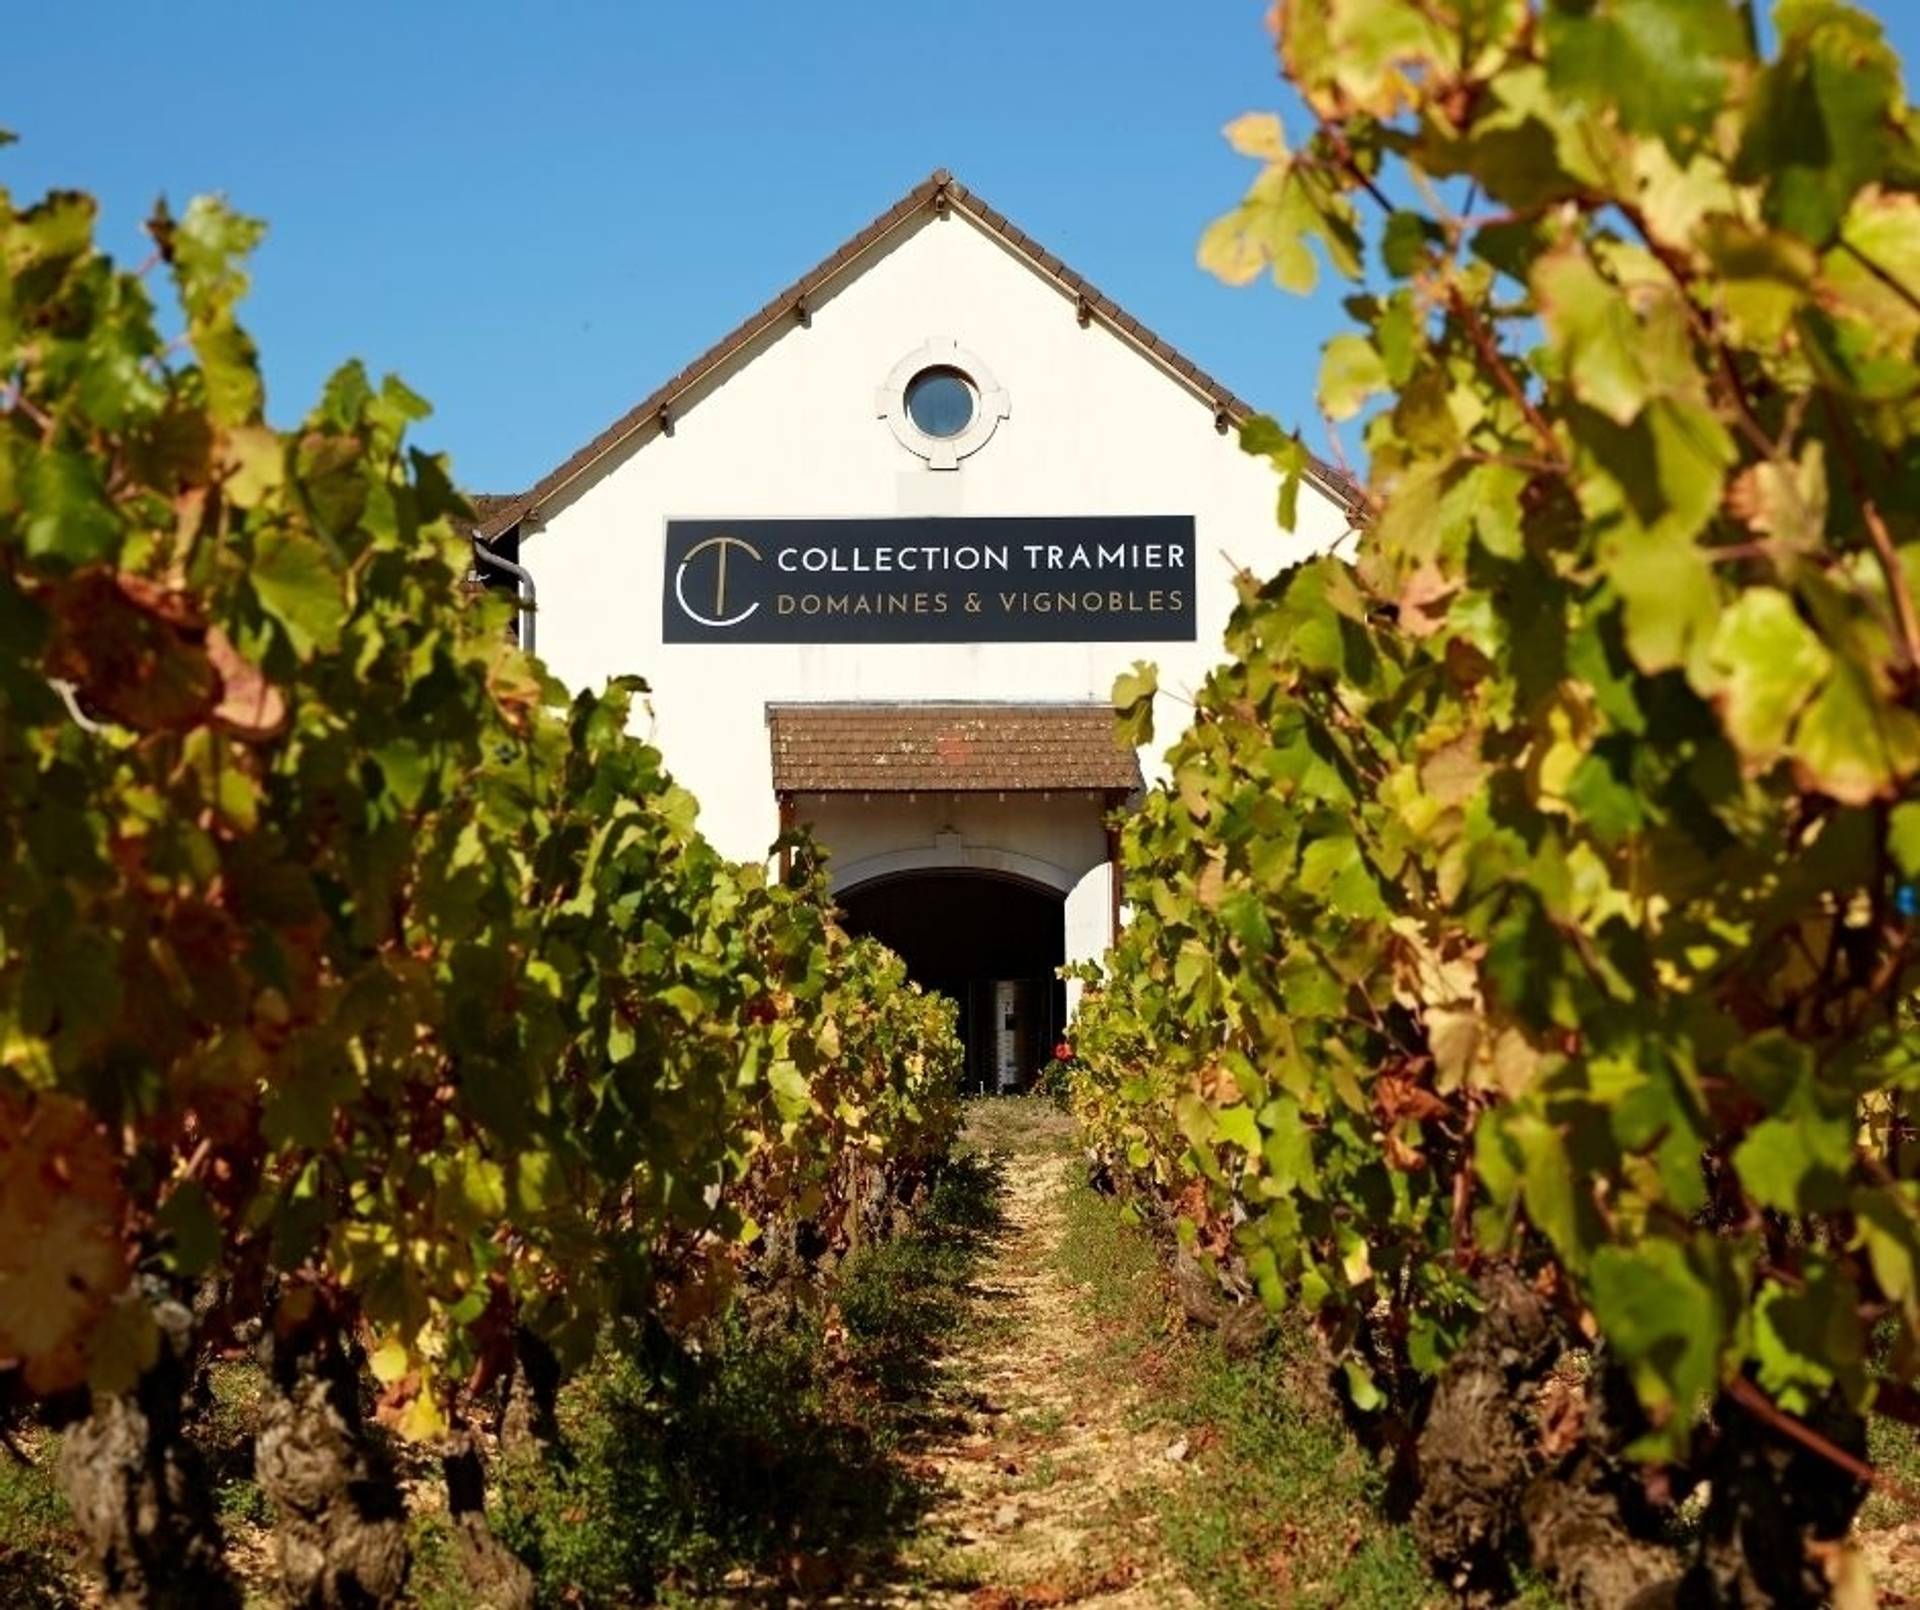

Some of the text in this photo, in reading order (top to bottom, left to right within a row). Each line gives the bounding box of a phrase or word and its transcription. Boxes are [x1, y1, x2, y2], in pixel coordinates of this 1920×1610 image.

[777, 543, 1186, 573] COLLECTION TRAMIER
[778, 590, 1184, 615] DOMAINES & VIGNOBLES
